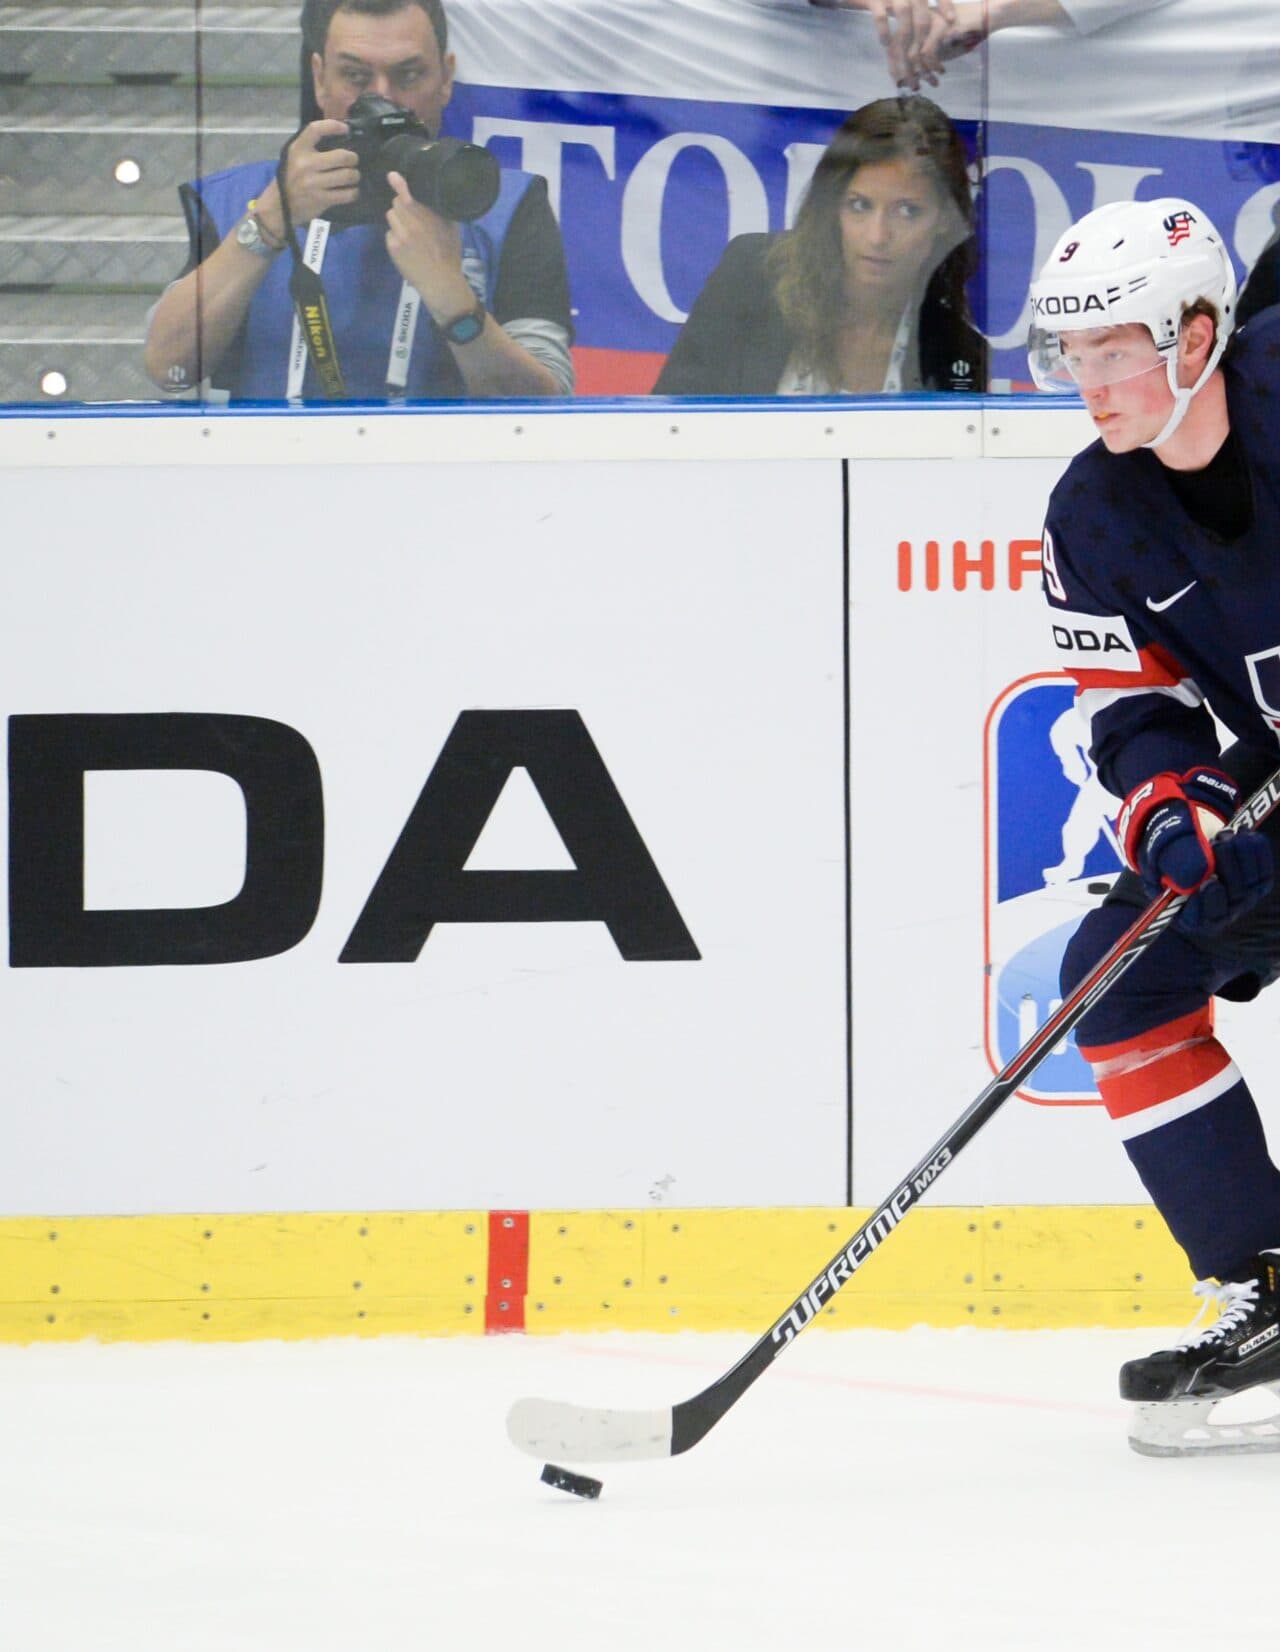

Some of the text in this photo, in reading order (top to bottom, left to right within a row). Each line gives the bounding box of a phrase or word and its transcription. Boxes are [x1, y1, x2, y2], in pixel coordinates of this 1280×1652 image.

[1163, 210, 1197, 247] USA
[1059, 241, 1080, 262] 9
[1031, 294, 1106, 317] KODA
[305, 305, 326, 358] Nikon
[1196, 773, 1238, 801] BAUER
[8, 708, 703, 967] DA
[771, 1147, 953, 1358] SUPREME MX3
